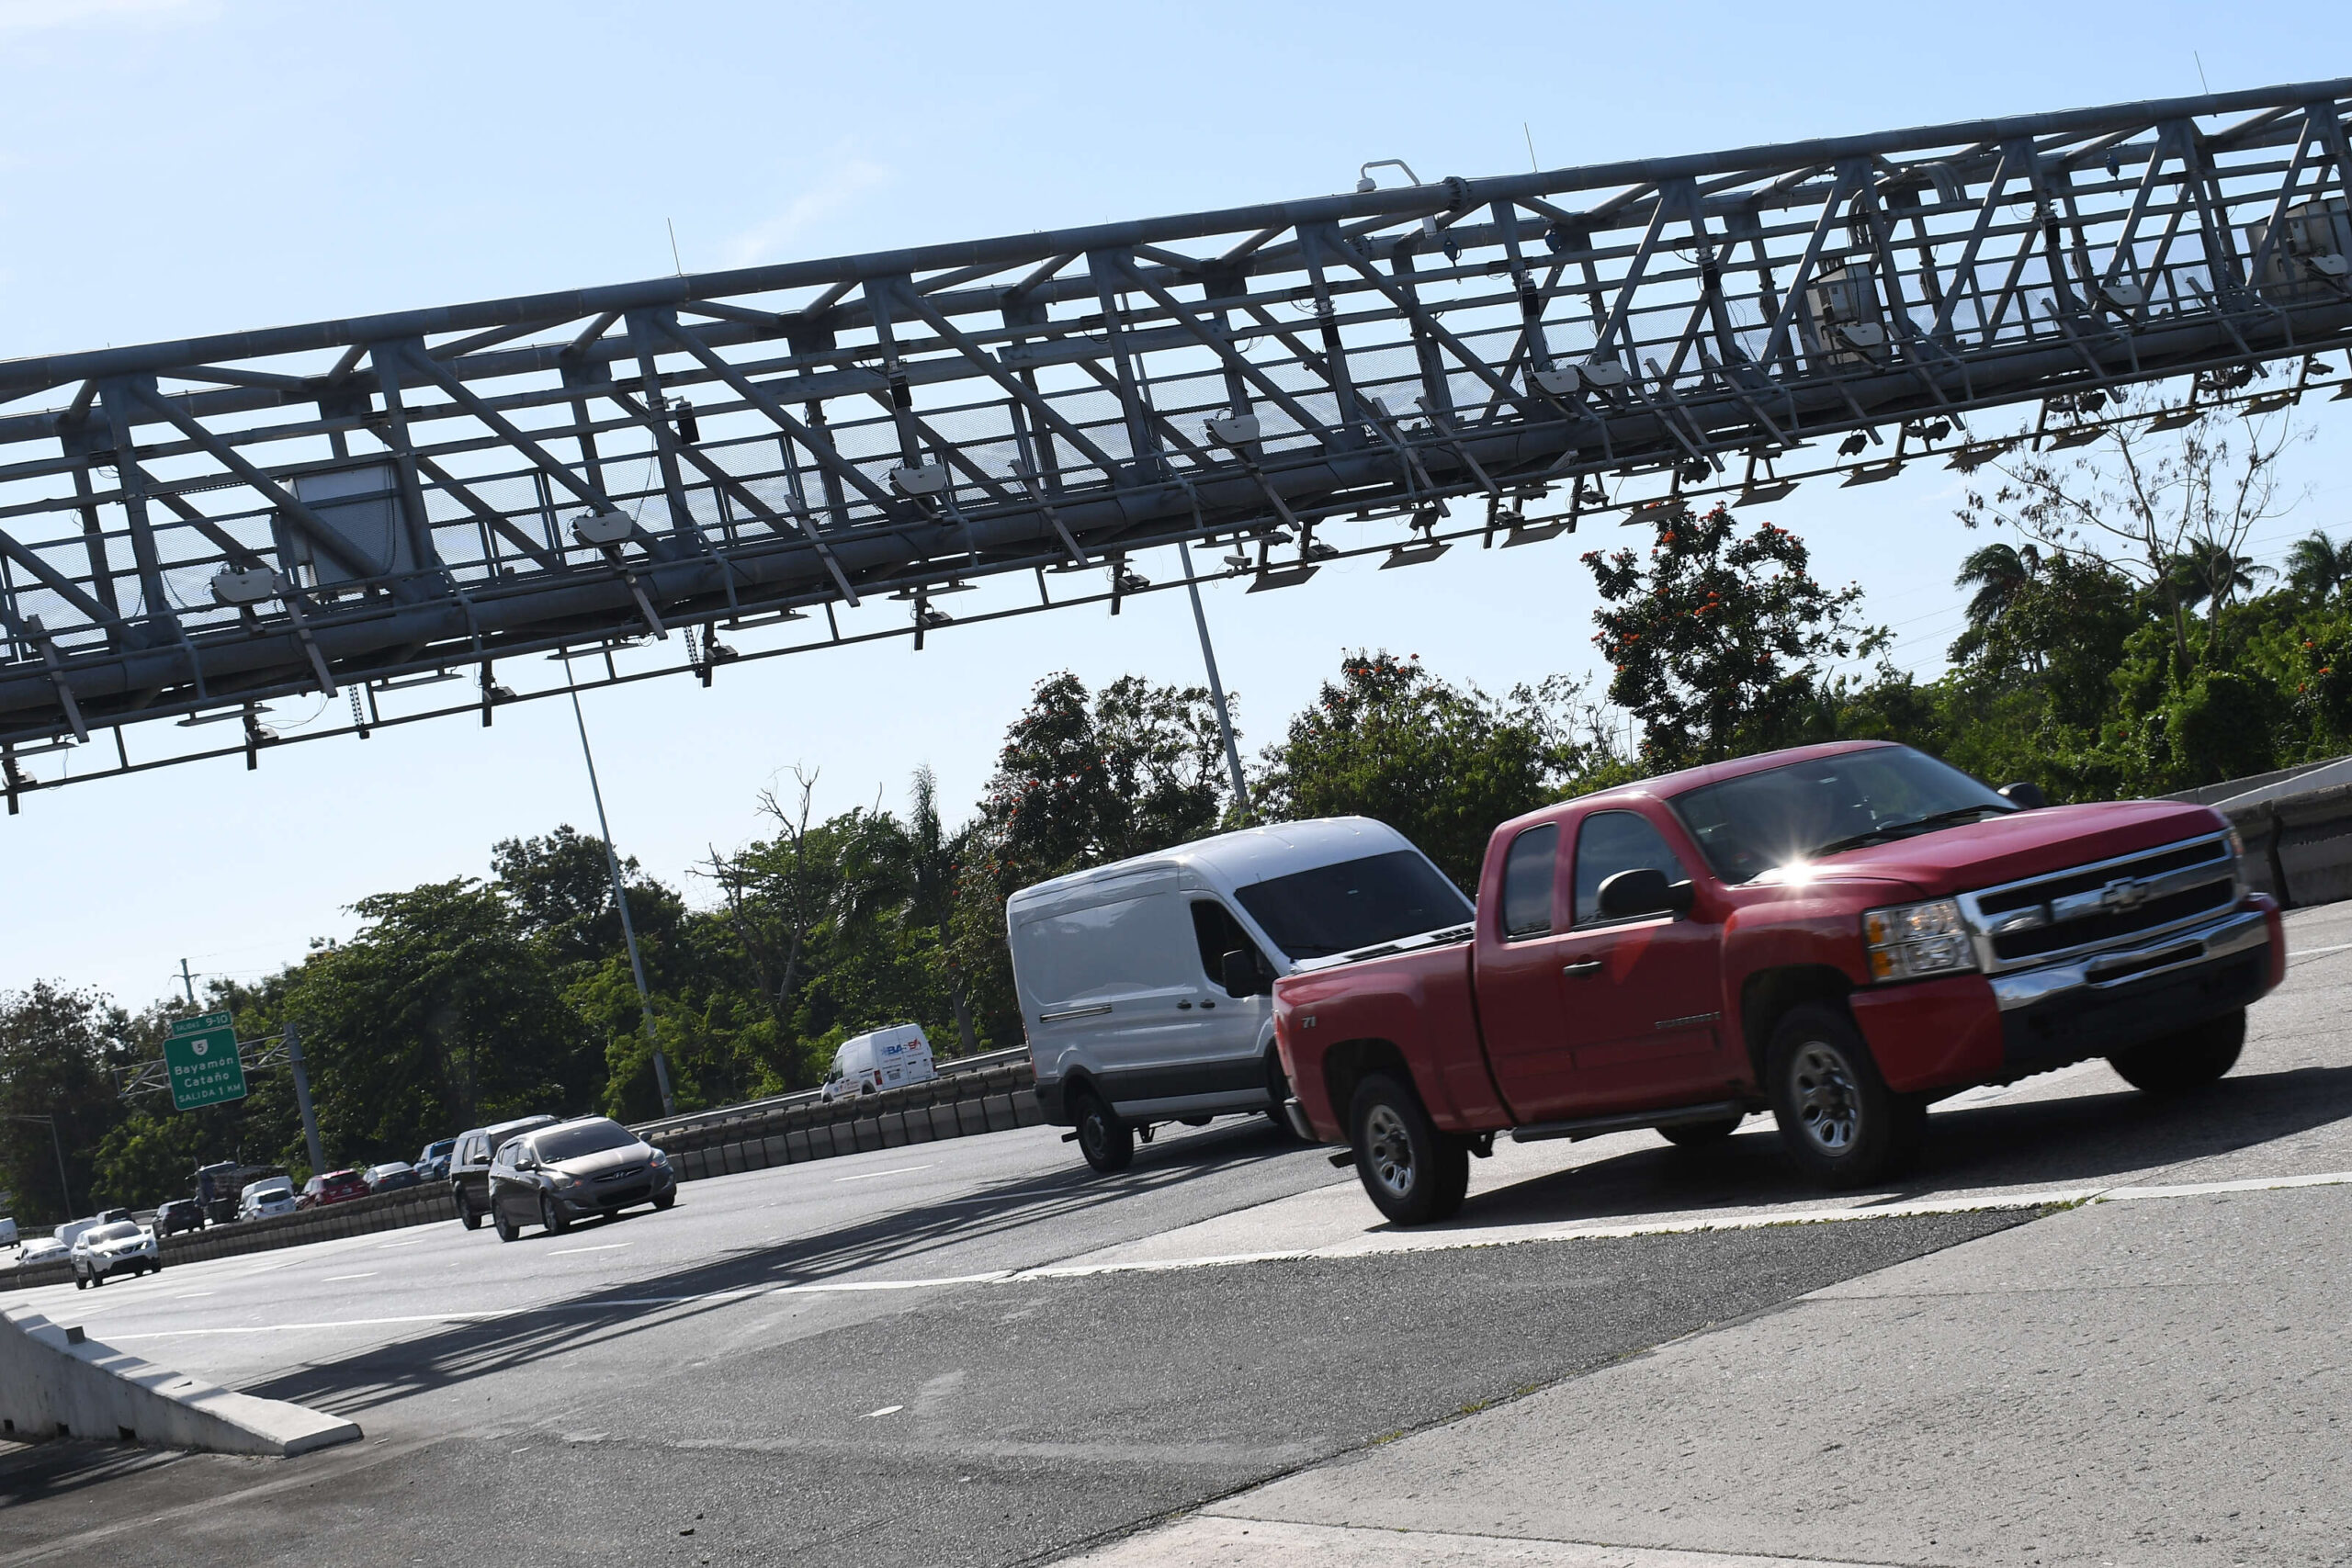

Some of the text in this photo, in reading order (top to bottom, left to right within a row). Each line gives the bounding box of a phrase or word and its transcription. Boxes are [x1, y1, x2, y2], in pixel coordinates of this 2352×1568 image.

[205, 1014, 229, 1027] 9-10
[198, 1043, 204, 1053] 5
[174, 1057, 234, 1076] Bayamón
[184, 1072, 230, 1088] Cataño
[178, 1084, 242, 1102] SALIDA 1 KM
